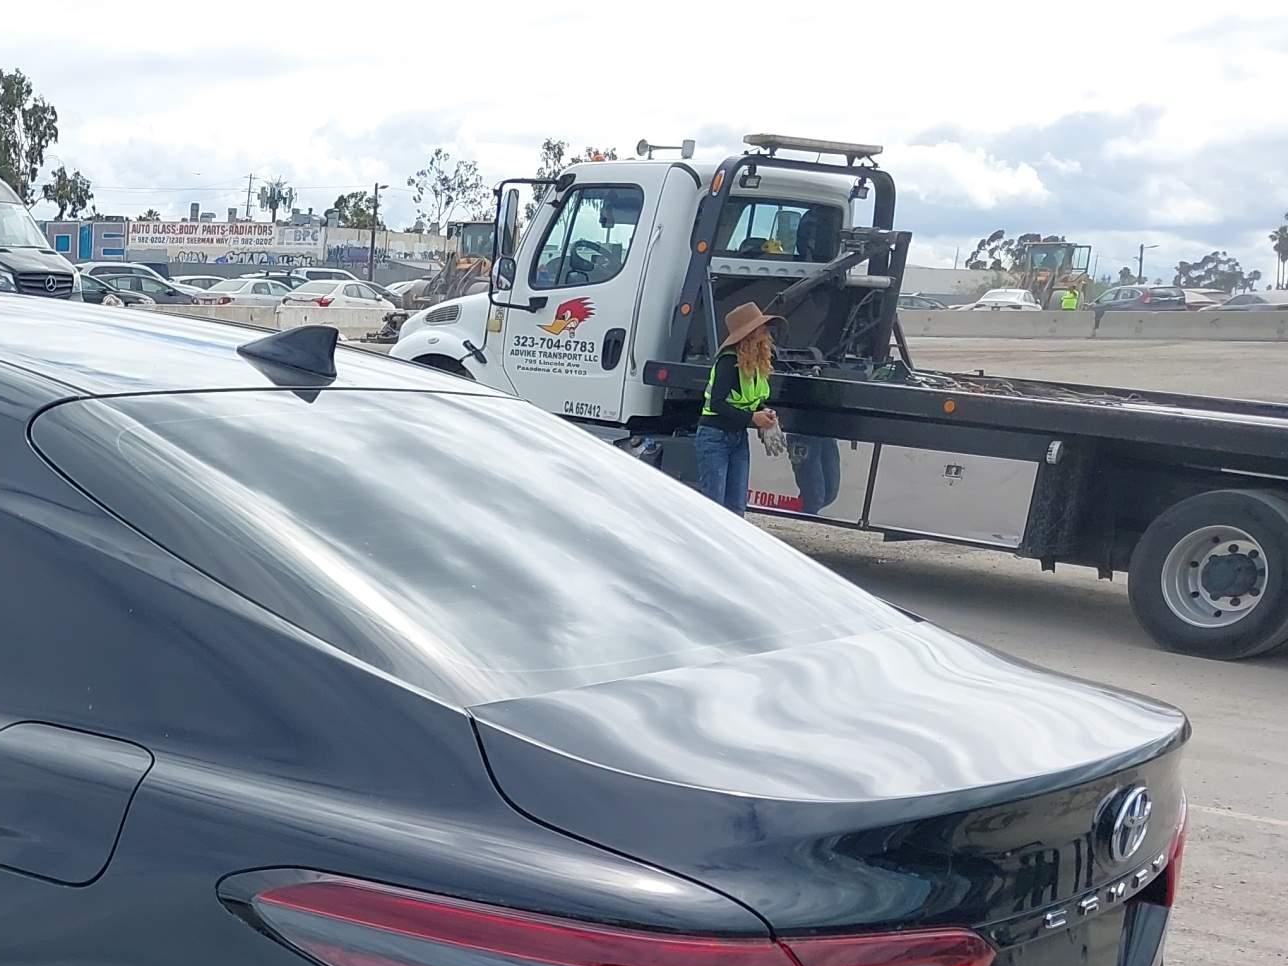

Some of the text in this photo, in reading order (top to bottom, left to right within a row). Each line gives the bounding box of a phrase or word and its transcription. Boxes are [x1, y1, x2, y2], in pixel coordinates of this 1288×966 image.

[131, 224, 150, 234] AUTO
[513, 335, 595, 353] 323-704-6783
[510, 349, 598, 362] ADVIKE TRANSPORT LLC
[516, 365, 551, 373] Pasadena
[539, 359, 565, 367] Lincoln
[564, 400, 574, 414] CA
[575, 402, 601, 417] 657412
[754, 491, 775, 507] FOR
[1043, 854, 1165, 929] CAMRY
